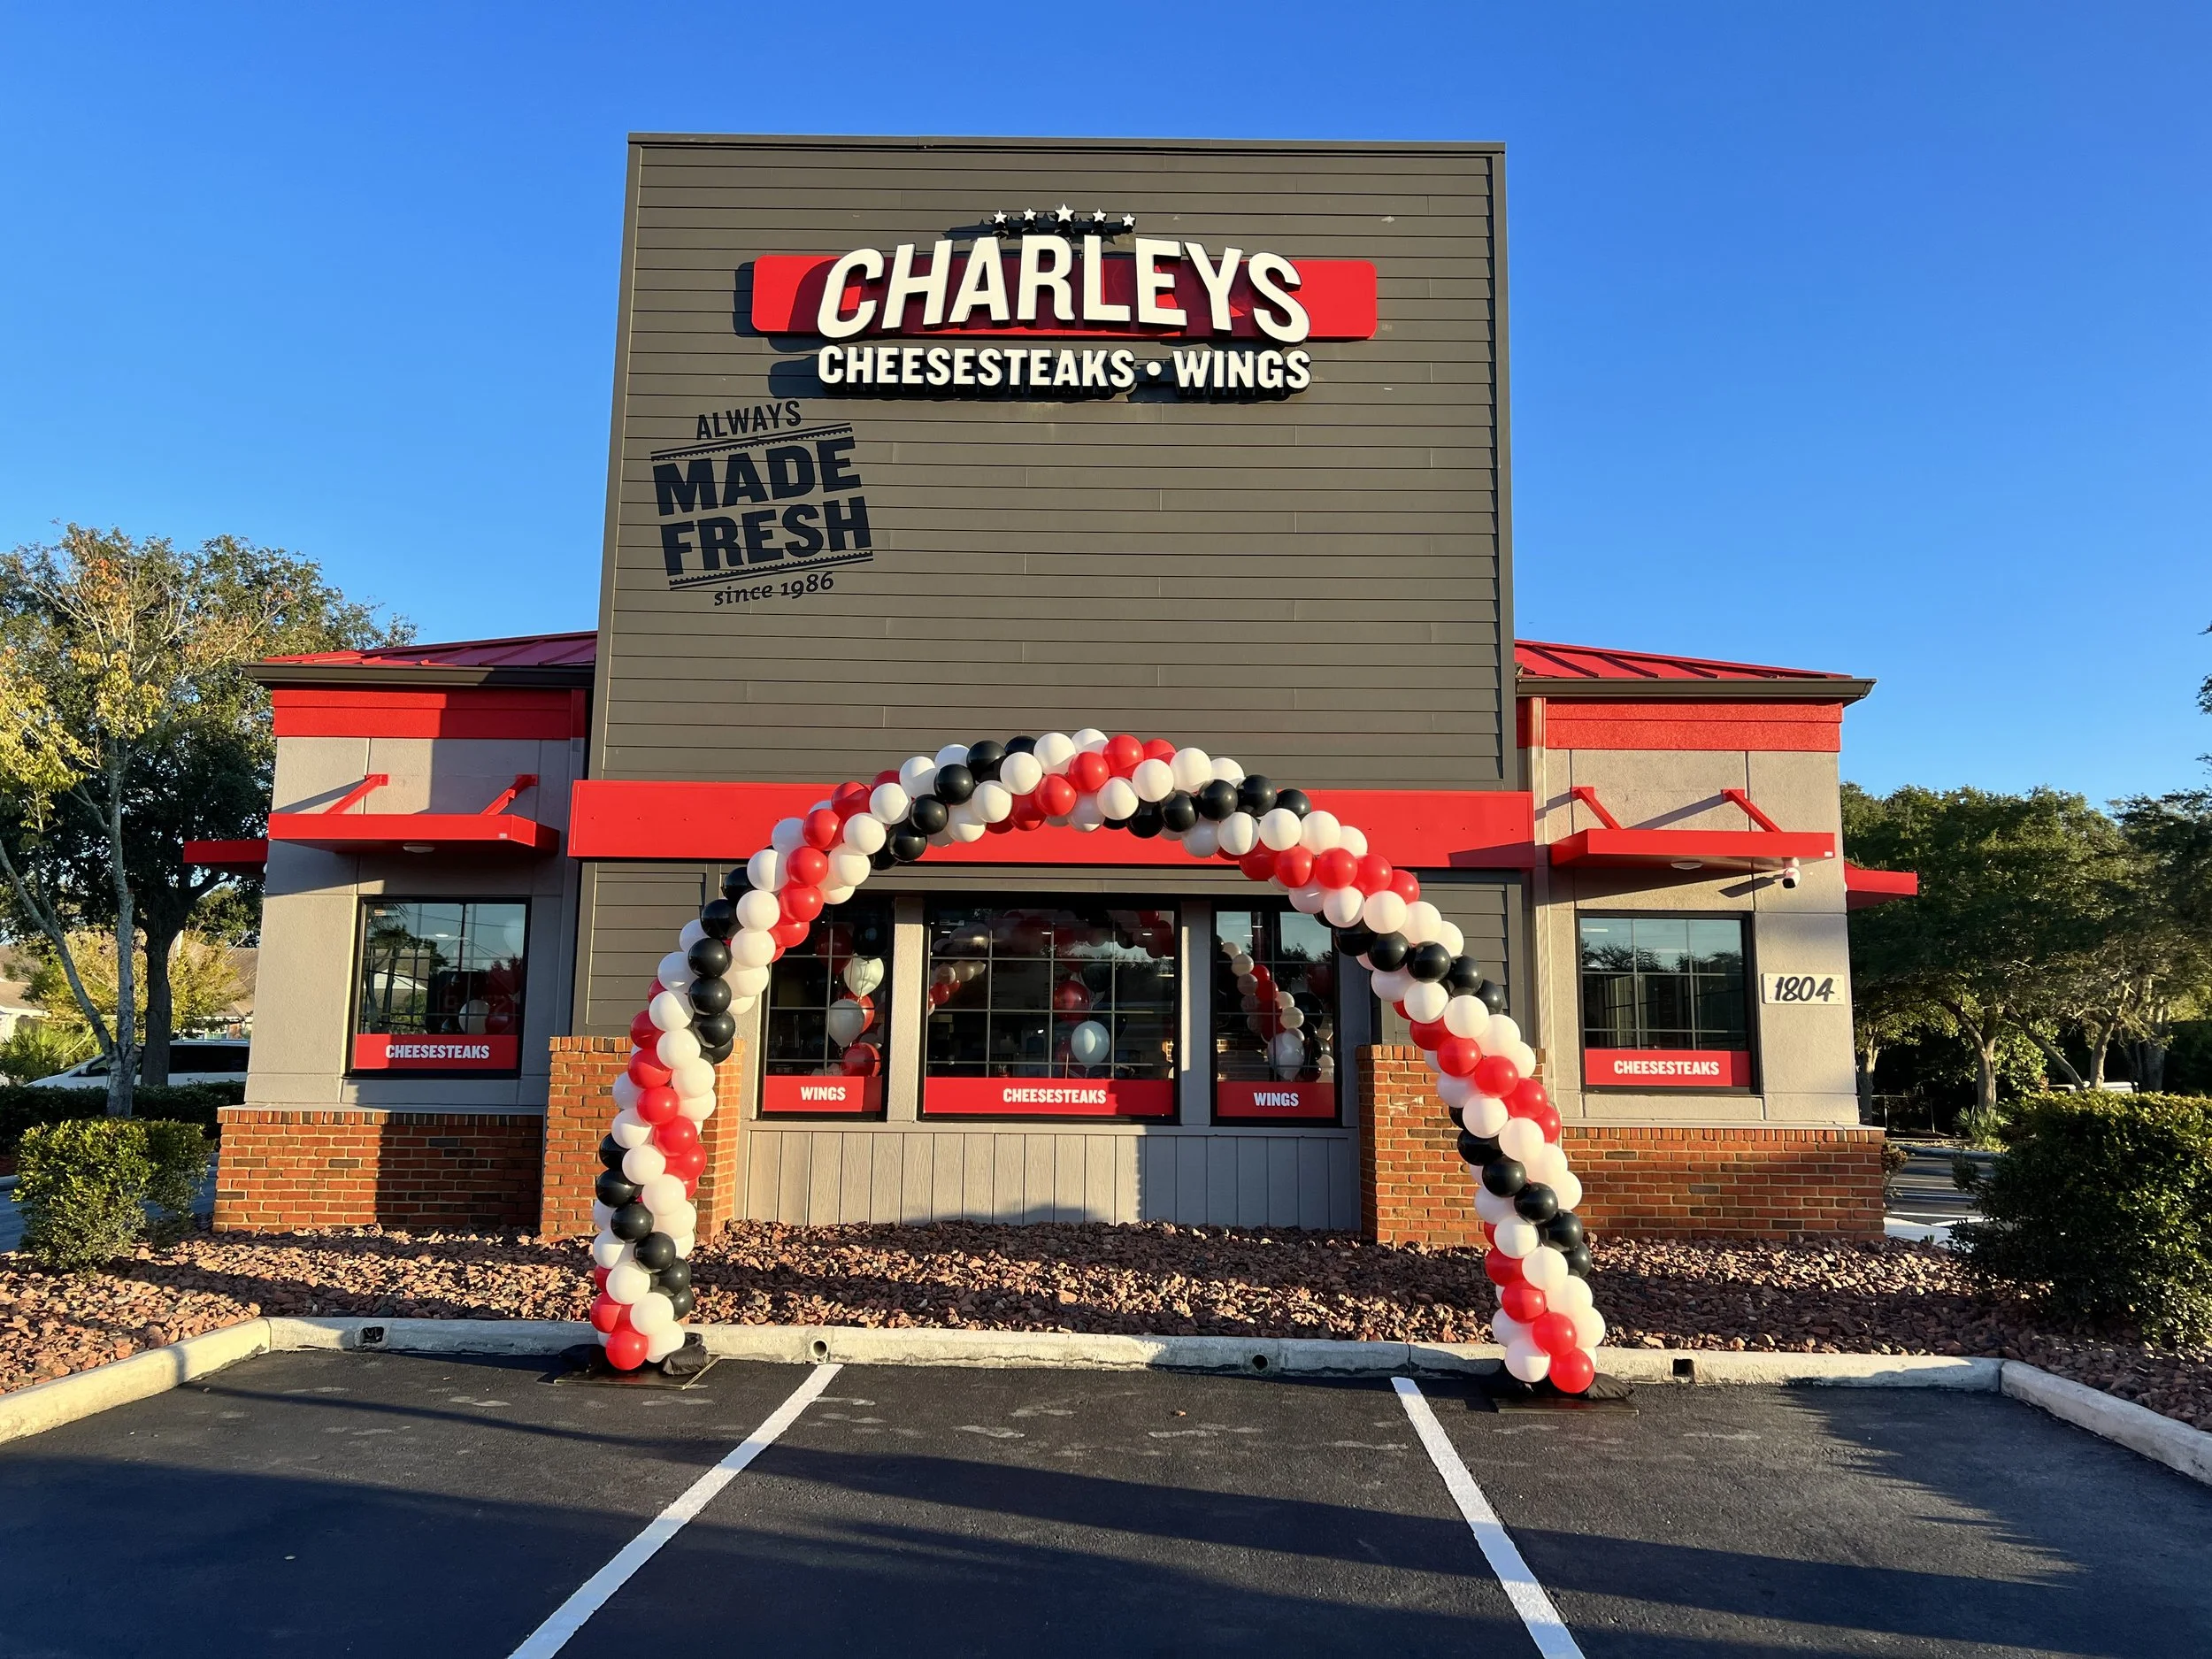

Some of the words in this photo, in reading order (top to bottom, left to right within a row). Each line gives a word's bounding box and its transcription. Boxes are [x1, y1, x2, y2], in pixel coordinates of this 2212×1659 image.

[817, 235, 1310, 344] CHARLEYS
[818, 346, 1135, 389] CHEESESTEAKS
[1172, 349, 1310, 389] WINGS
[696, 401, 802, 441] ALWAYS
[653, 436, 863, 516] MADE
[661, 495, 872, 576] FRESH
[714, 583, 773, 606] since
[780, 572, 835, 599] 1986
[1774, 976, 1834, 1002] 1804
[385, 1044, 490, 1059] CHEESESTEAKS
[1613, 1060, 1720, 1076] CHEESESTEAKS
[800, 1086, 847, 1101] WINGS
[1002, 1087, 1107, 1105] CHEESESTEAKS
[1253, 1092, 1300, 1108] WINGS
